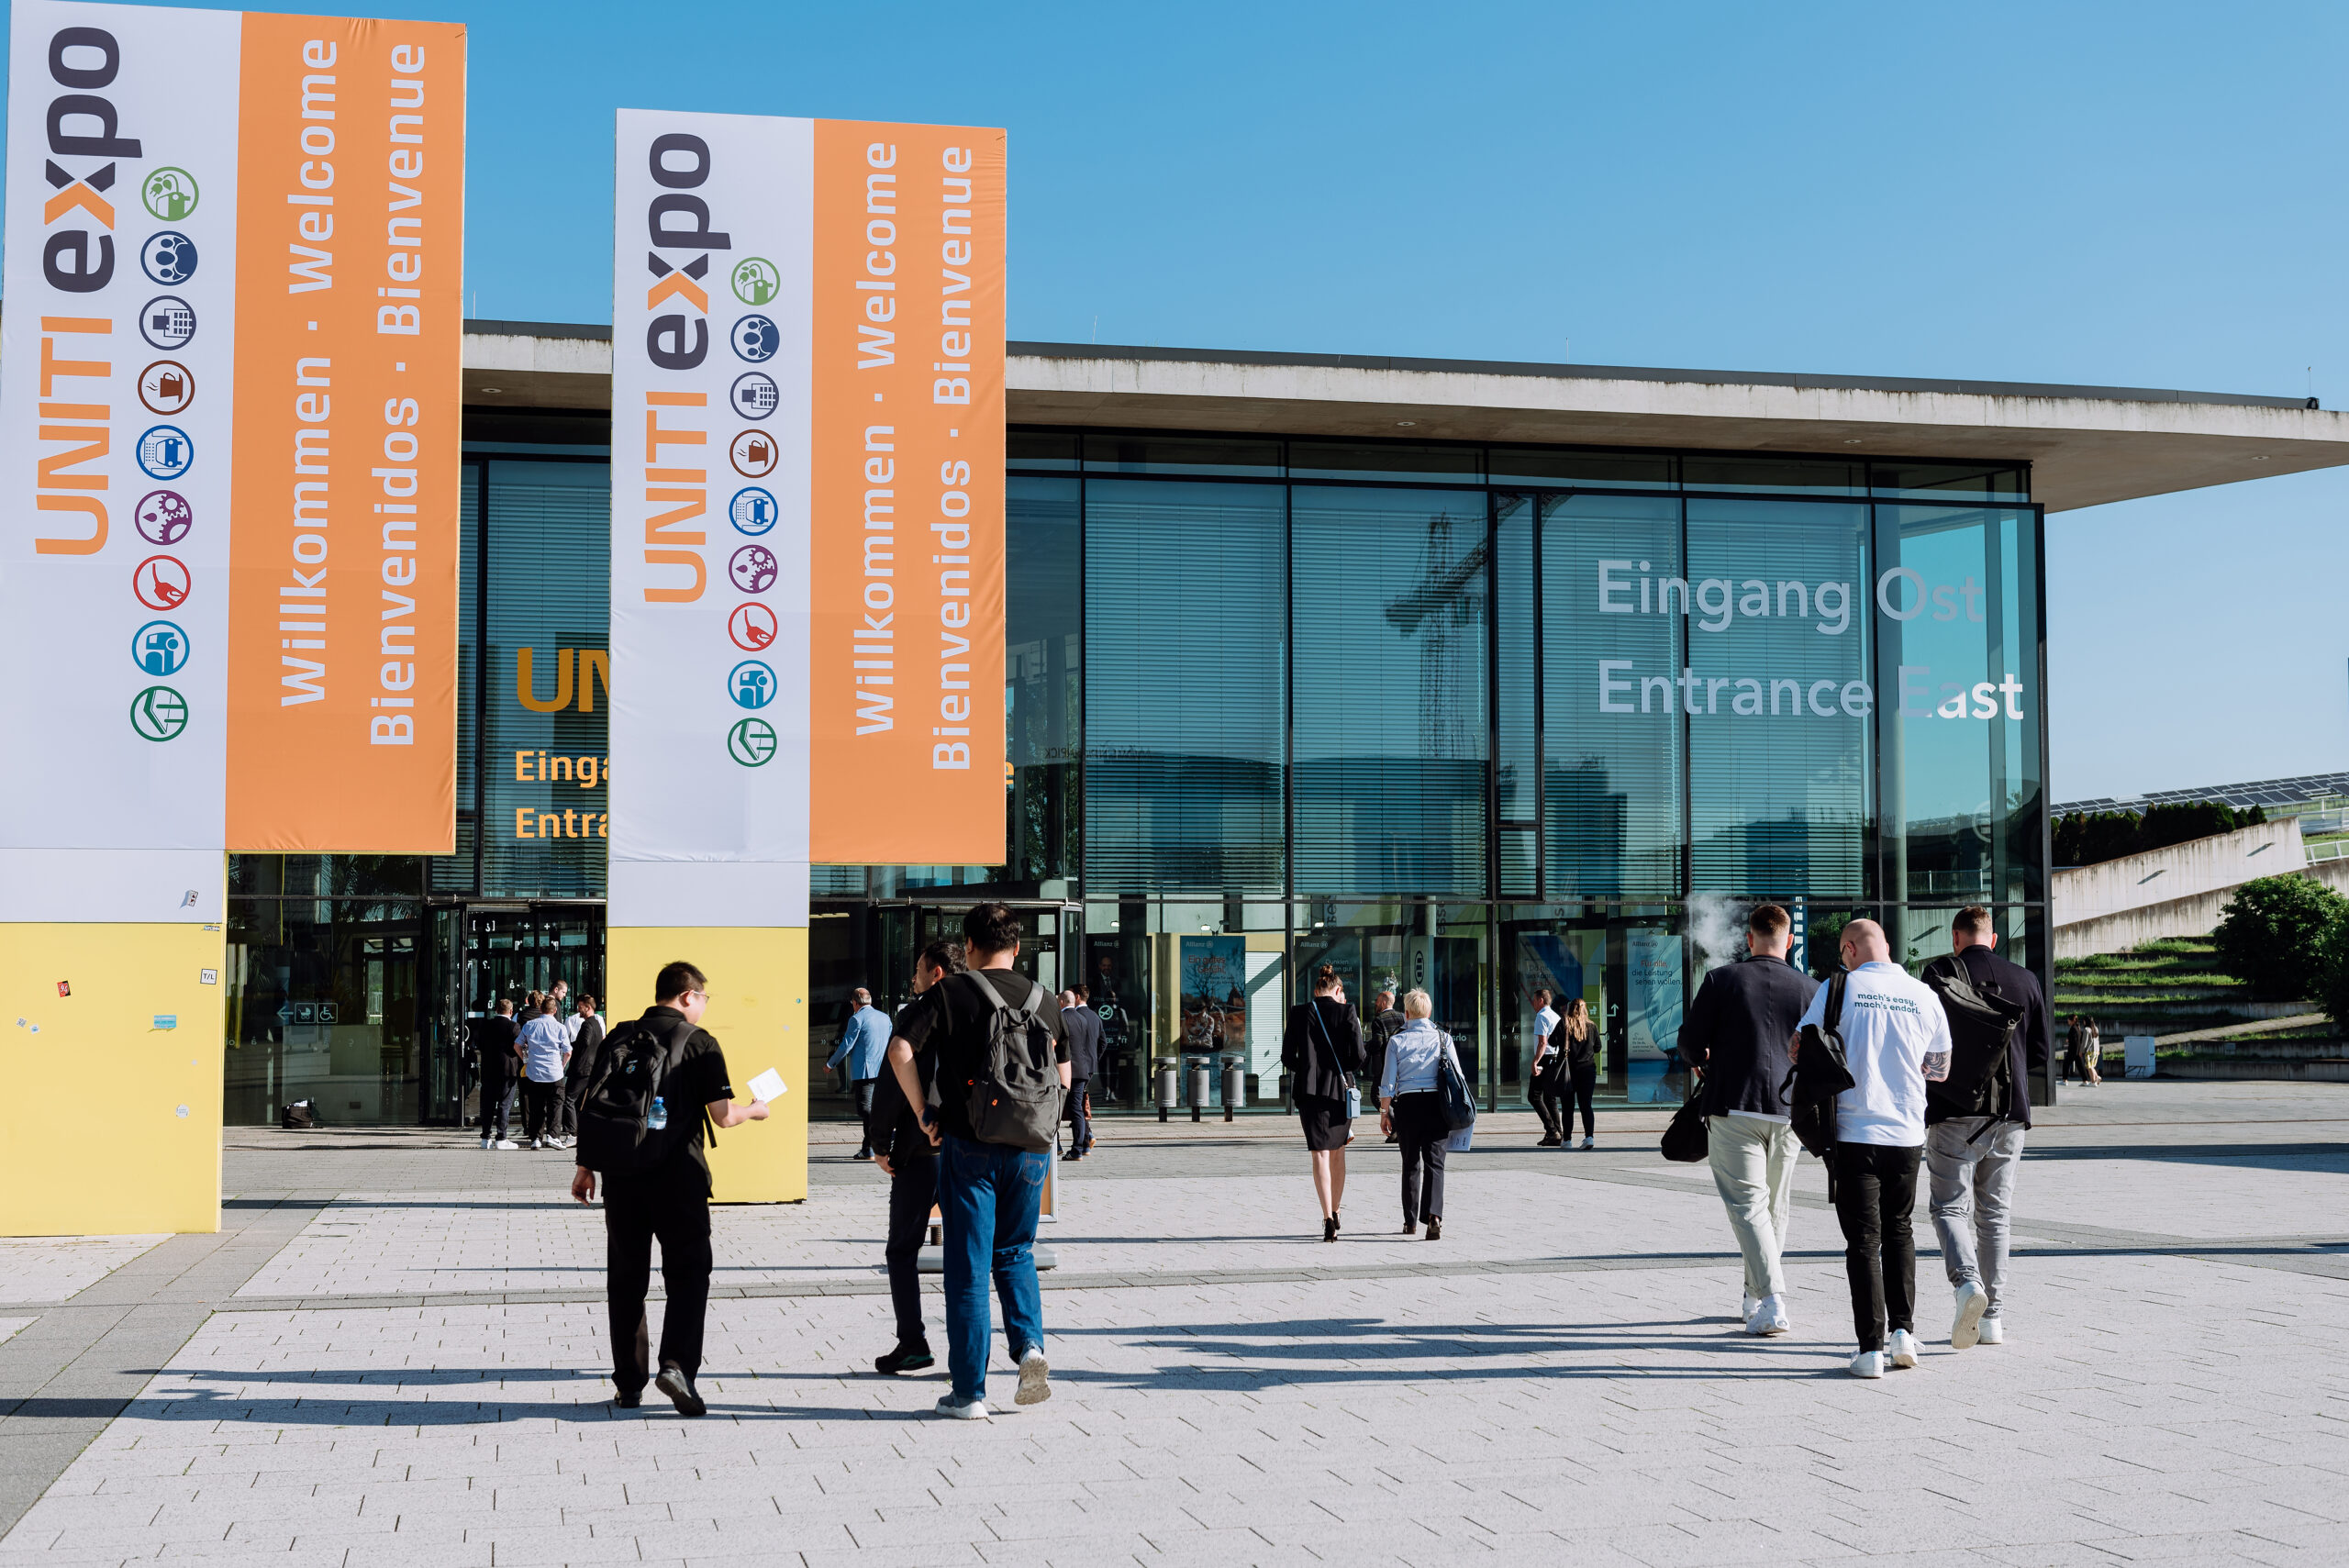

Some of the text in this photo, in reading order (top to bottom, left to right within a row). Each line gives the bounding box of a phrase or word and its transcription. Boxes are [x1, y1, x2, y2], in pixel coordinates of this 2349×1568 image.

[35, 27, 143, 556] UNITI expo
[287, 39, 338, 295] Welcome
[377, 44, 425, 336] Bienvenue
[855, 142, 896, 370] Welcome
[933, 146, 973, 406] Bienvenue
[643, 133, 732, 603] UNITI expo
[279, 357, 331, 707] Willkommen
[370, 397, 419, 745] Bienvenidos
[853, 425, 895, 736] Willkommen
[930, 460, 971, 770] Bienvenidos
[1598, 559, 1985, 635] Eingang Ost
[1598, 659, 2024, 720] Entrance East
[1634, 977, 1656, 985] sehen
[1643, 969, 1673, 977] Leistung
[1854, 1001, 1921, 1015] mach's endori.
[1857, 993, 1917, 1006] mach's easy.
